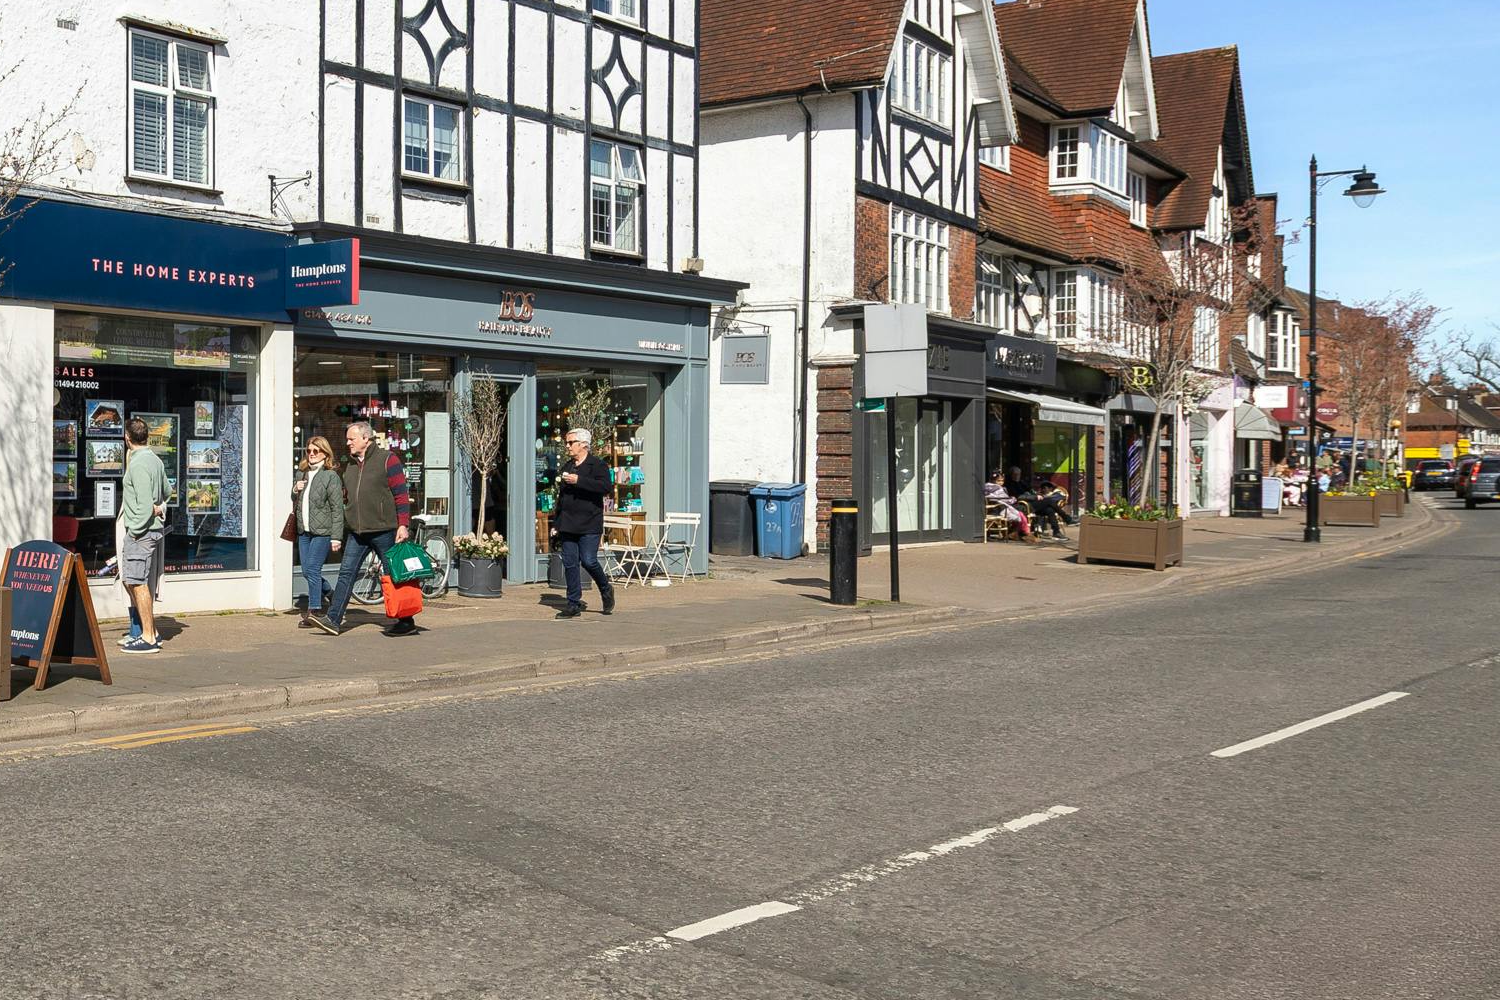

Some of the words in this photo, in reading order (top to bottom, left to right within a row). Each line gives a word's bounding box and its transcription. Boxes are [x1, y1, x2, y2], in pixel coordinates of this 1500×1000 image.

[92, 258, 124, 274] THE
[133, 263, 179, 280] HOME
[189, 269, 255, 288] EXPERTS
[291, 263, 346, 278] Hamptons
[498, 291, 535, 321] BOS
[54, 366, 94, 378] SALES
[54, 379, 75, 389] 01494
[75, 380, 100, 390] 216002
[16, 551, 61, 570] HERE
[181, 563, 224, 571] INTERNATIONAL
[13, 570, 51, 582] WHENEVER
[10, 581, 24, 589] YOU
[25, 582, 43, 592] NEED
[43, 585, 53, 593] US
[10, 629, 40, 641] mptons
